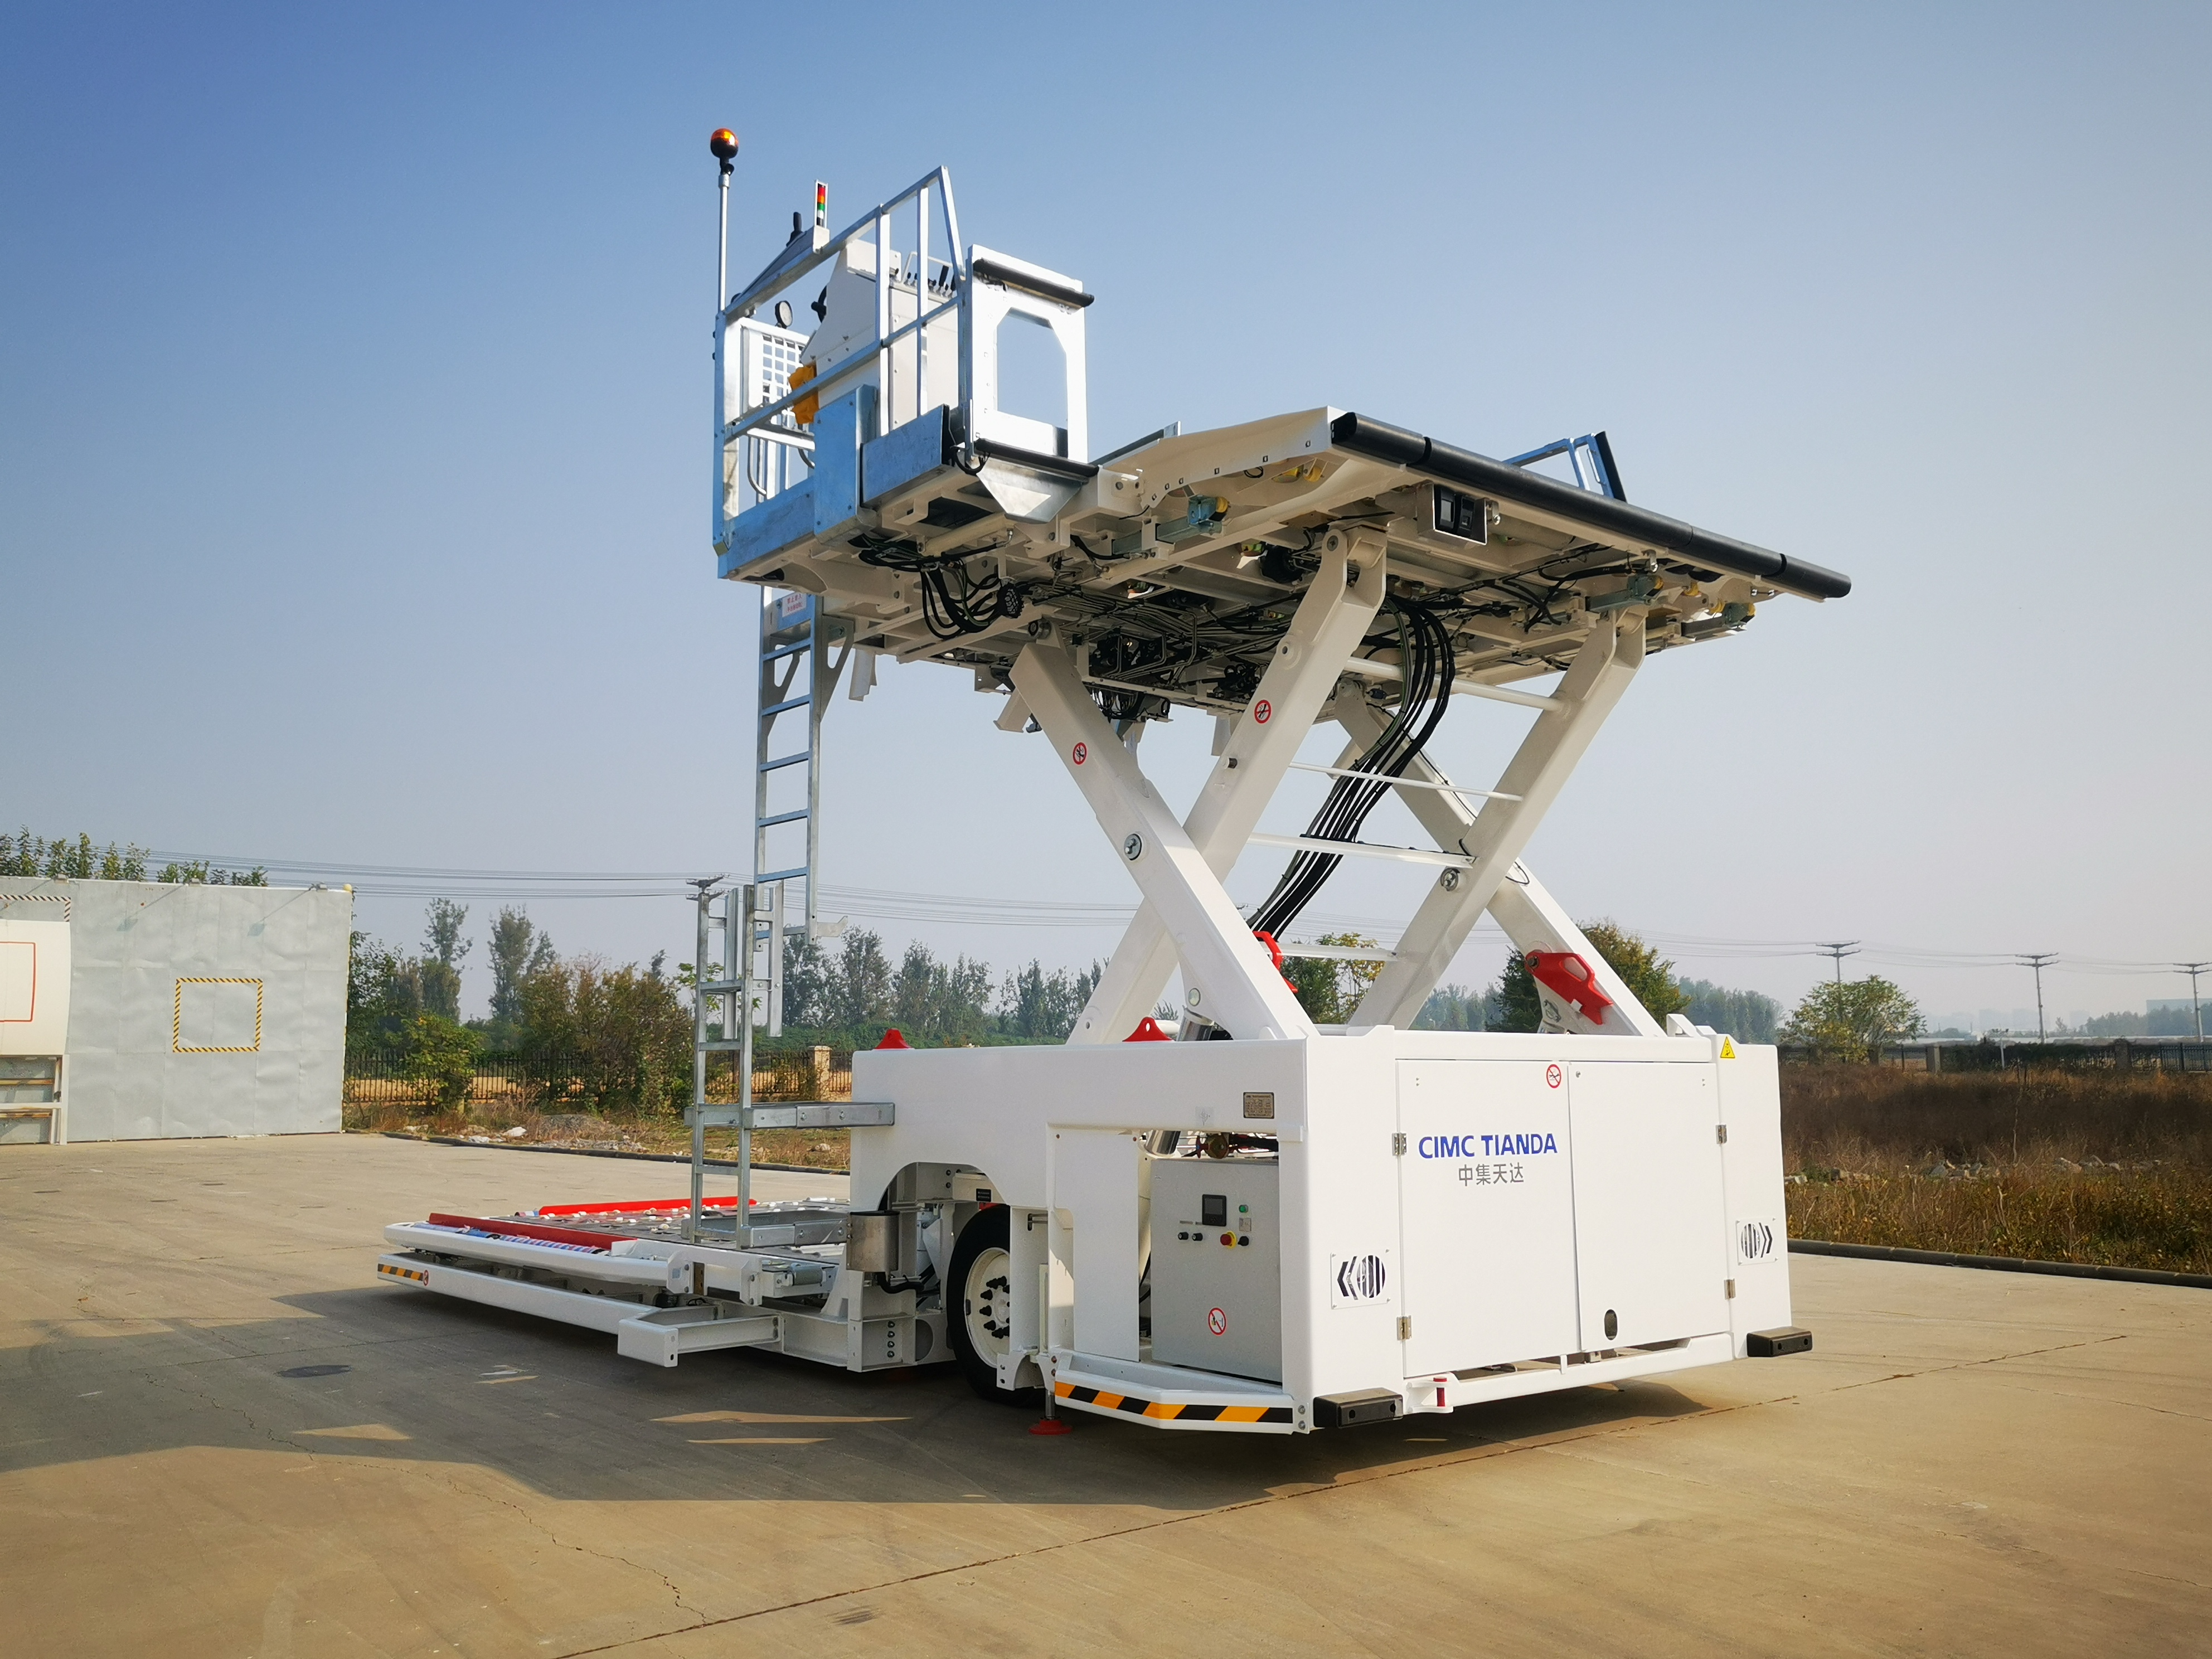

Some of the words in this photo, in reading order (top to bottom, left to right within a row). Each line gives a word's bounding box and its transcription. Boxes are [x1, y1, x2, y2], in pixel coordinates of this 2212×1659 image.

[1419, 1136, 1474, 1158] CIMC
[1481, 1134, 1557, 1156] TIANDA
[1459, 1162, 1524, 1186] 中集天达
